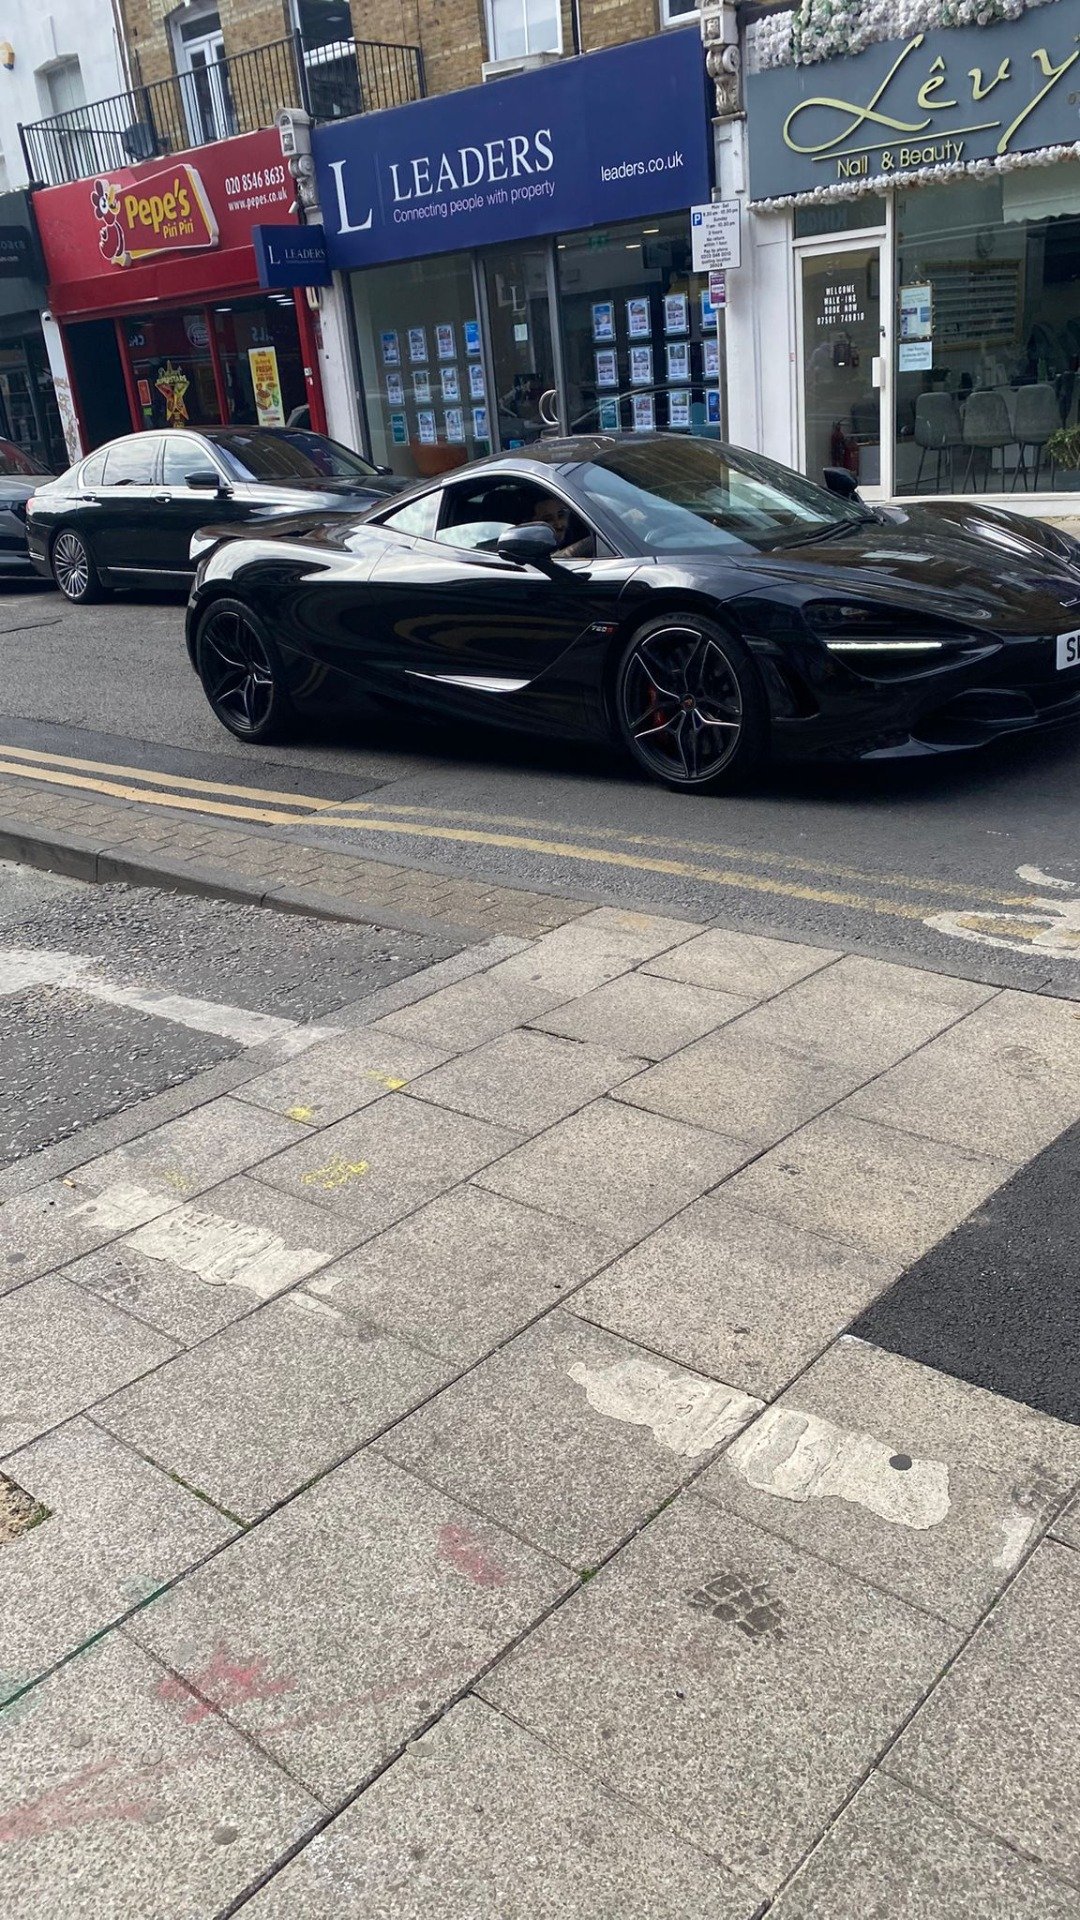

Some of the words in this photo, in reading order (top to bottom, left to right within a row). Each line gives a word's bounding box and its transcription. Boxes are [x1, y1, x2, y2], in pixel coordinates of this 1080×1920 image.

[389, 128, 554, 201] LEADERS
[601, 150, 684, 182] leaders.co.uk
[837, 155, 868, 178] Nail
[881, 151, 895, 170] &
[900, 140, 964, 168] Beauty
[225, 176, 241, 195] 020
[242, 170, 263, 191] 8546
[264, 165, 285, 186] 8633
[124, 178, 190, 233] Pepe's
[228, 186, 288, 211] www.pepes.co.uk
[328, 160, 373, 234] L
[393, 202, 448, 223] Connecting
[450, 193, 484, 215] people
[486, 189, 508, 206] with
[511, 180, 555, 204] property
[163, 221, 178, 239] Piri
[179, 218, 194, 236] Piri
[268, 245, 281, 264] L
[823, 294, 856, 306] WALK-INS
[825, 284, 855, 296] WELCOME
[824, 305, 840, 315] BOOK
[844, 303, 857, 313] NOW
[1066, 635, 1080, 662] S
